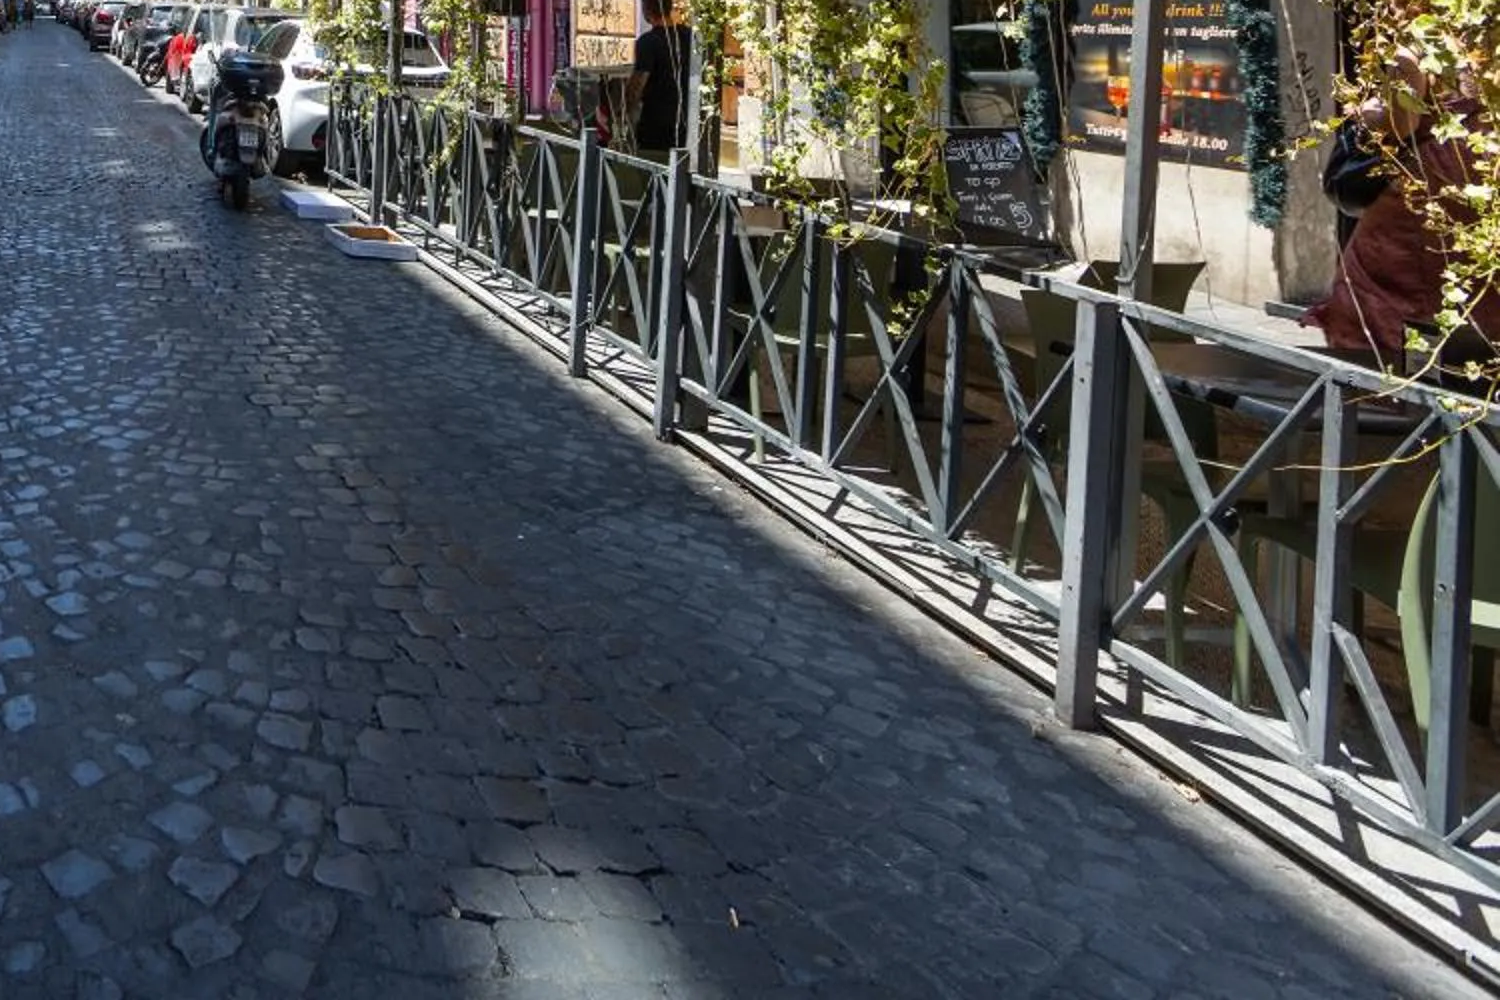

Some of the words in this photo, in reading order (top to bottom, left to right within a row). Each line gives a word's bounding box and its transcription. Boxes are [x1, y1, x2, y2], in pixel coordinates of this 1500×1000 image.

[1091, 2, 1109, 17] All
[1165, 2, 1204, 18] drink
[1191, 136, 1229, 151] 18.00
